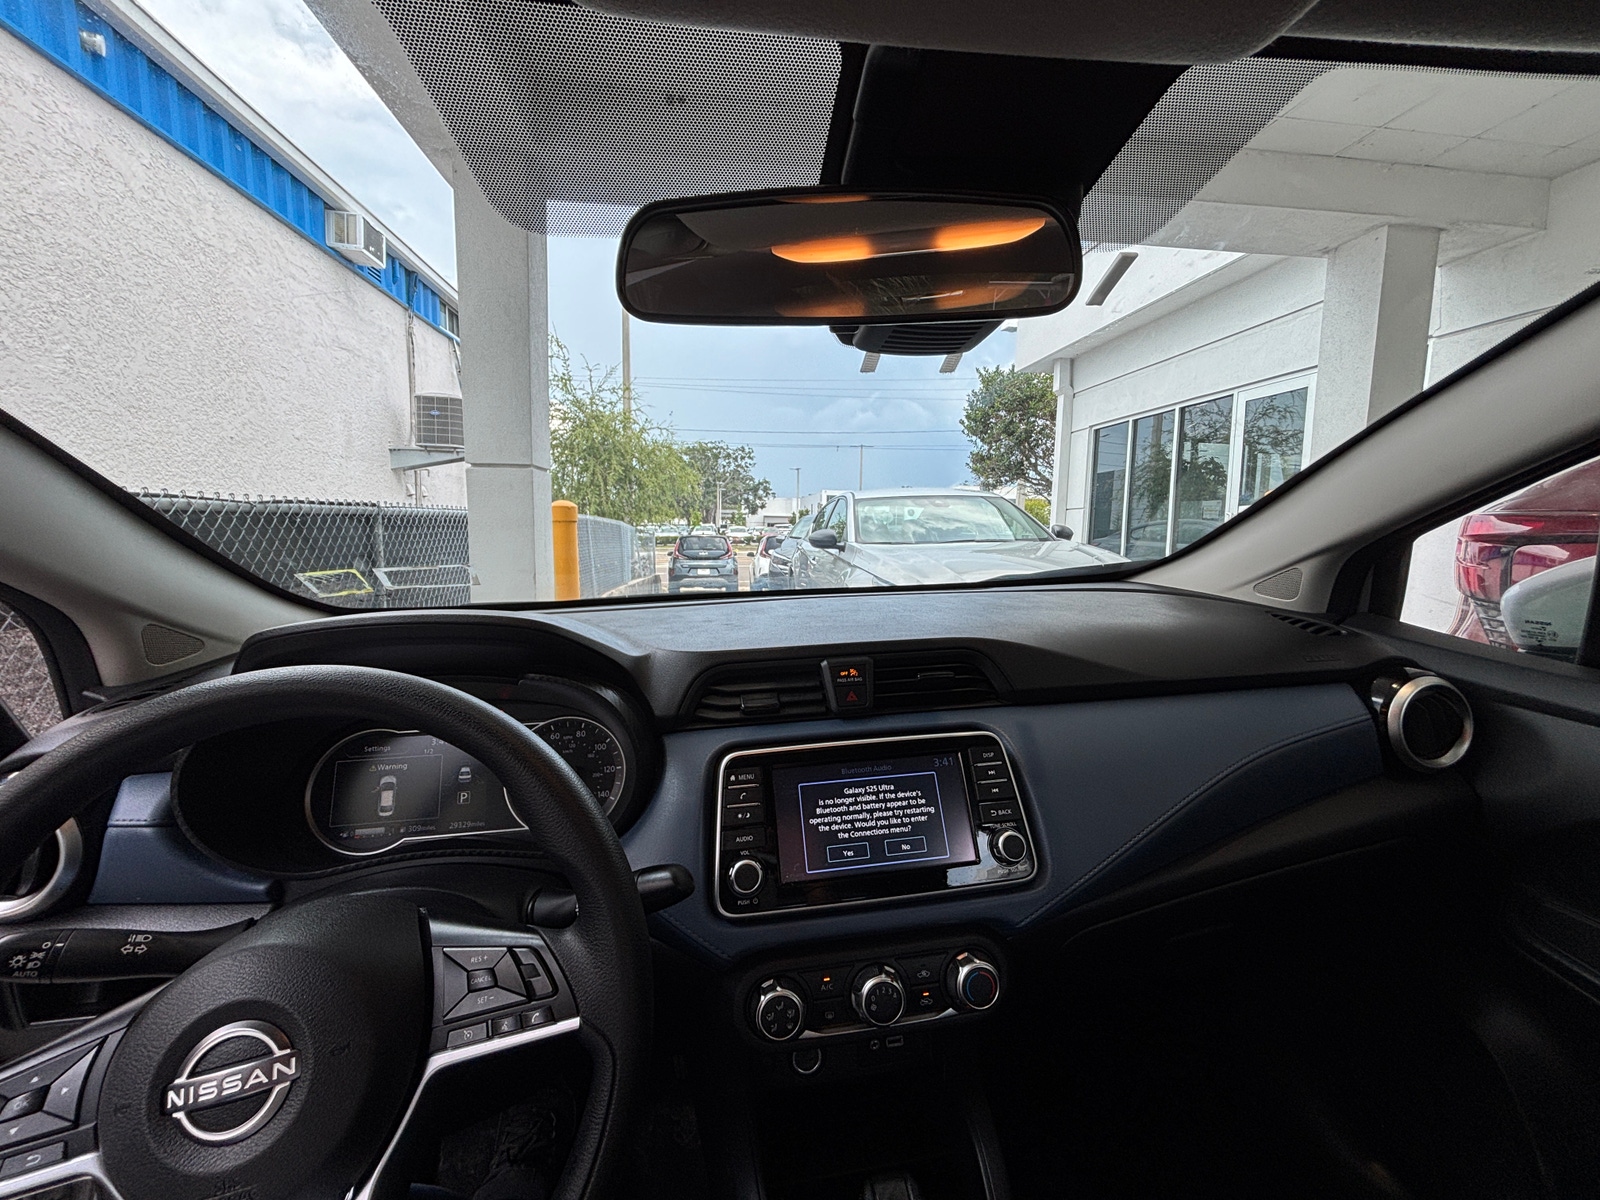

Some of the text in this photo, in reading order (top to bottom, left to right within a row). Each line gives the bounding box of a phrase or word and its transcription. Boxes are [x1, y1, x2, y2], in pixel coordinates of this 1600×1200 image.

[594, 743, 607, 751] 100
[378, 763, 408, 772] Warning
[932, 756, 954, 768] 3:41
[603, 765, 616, 773] 120
[841, 764, 893, 775] Bluetooth Audio
[597, 790, 610, 798] 140
[844, 786, 866, 796] Galaxy
[878, 784, 894, 792] Ultra
[460, 792, 468, 803] P
[834, 796, 856, 806] longer
[856, 794, 878, 802] visible.
[884, 792, 896, 800] the
[896, 790, 922, 798] device's
[816, 806, 848, 815] Bluetooth
[848, 804, 862, 812] and
[862, 802, 886, 811] battery
[886, 800, 909, 809] appear
[808, 815, 842, 825] operating
[872, 810, 894, 820] please
[894, 808, 904, 817] try
[904, 806, 936, 815] restarting
[818, 824, 830, 832] the
[830, 822, 854, 830] device.
[854, 820, 876, 828] Would
[876, 820, 890, 829] you
[890, 817, 902, 826] like
[910, 815, 928, 823] enter
[838, 825, 912, 840] the Connections menu?
[842, 850, 854, 858] Yes
[470, 955, 482, 964] RES
[470, 974, 492, 984] CANCEL
[820, 982, 834, 992] A/C
[477, 995, 488, 1004] SET
[166, 1056, 297, 1109] NISSAN
